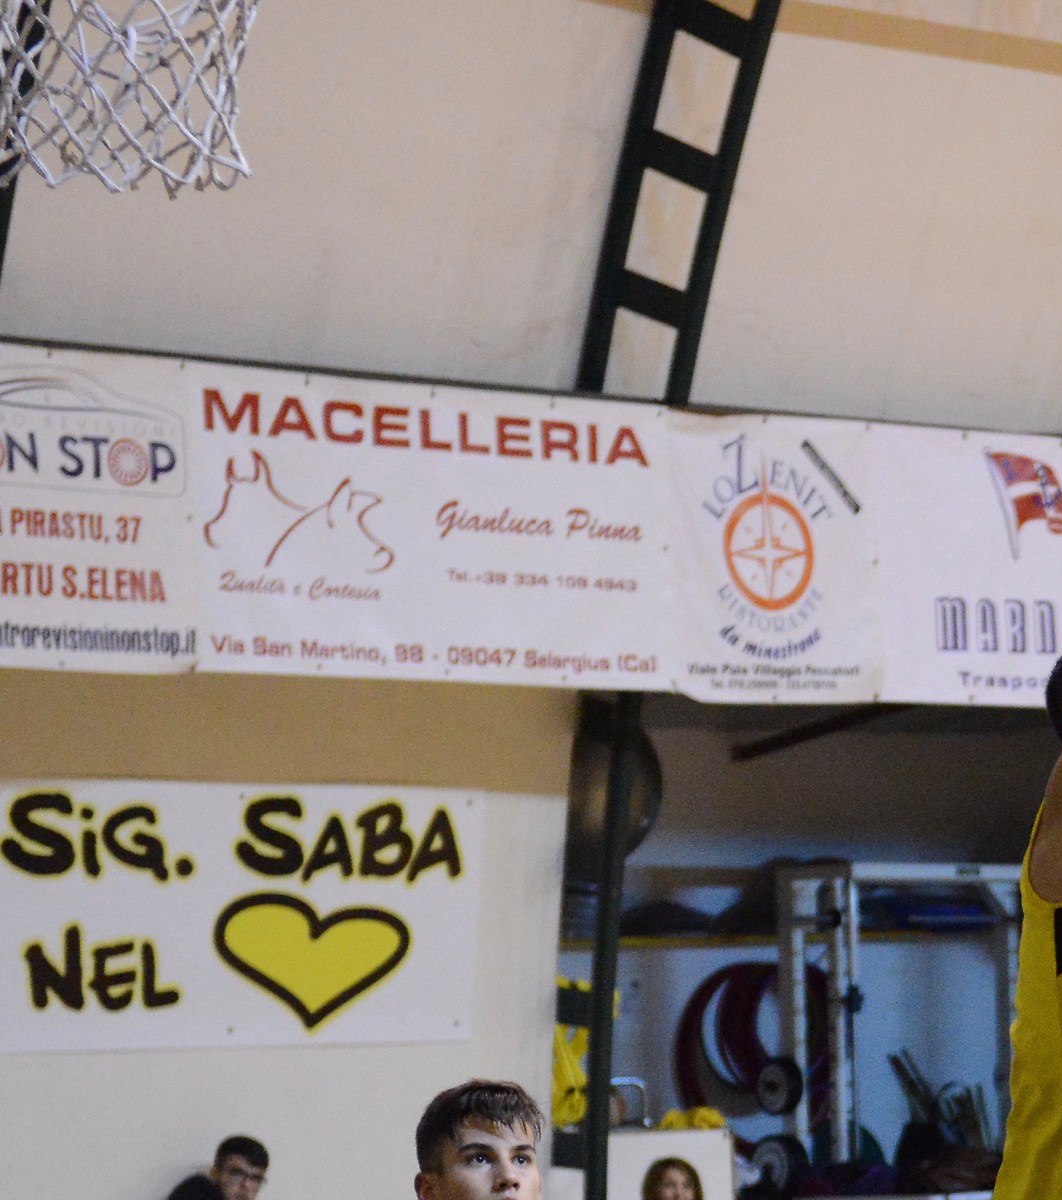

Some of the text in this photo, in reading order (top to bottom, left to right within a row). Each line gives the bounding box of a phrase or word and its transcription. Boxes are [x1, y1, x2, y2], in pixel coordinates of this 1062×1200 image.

[203, 388, 650, 467] MACELLERIA
[0, 431, 176, 485] N STOP
[115, 514, 142, 544] 37
[436, 499, 643, 543] Gianluca Pinna
[1, 561, 166, 604] RTU S.ELENA
[309, 576, 381, 601] Cortesia
[210, 633, 245, 655] Via
[252, 635, 293, 658] San
[300, 638, 388, 665] Martino,
[447, 645, 517, 667] 09047
[524, 649, 611, 674] Selargius
[236, 794, 462, 882] SABA
[24, 924, 180, 1010] NEL
